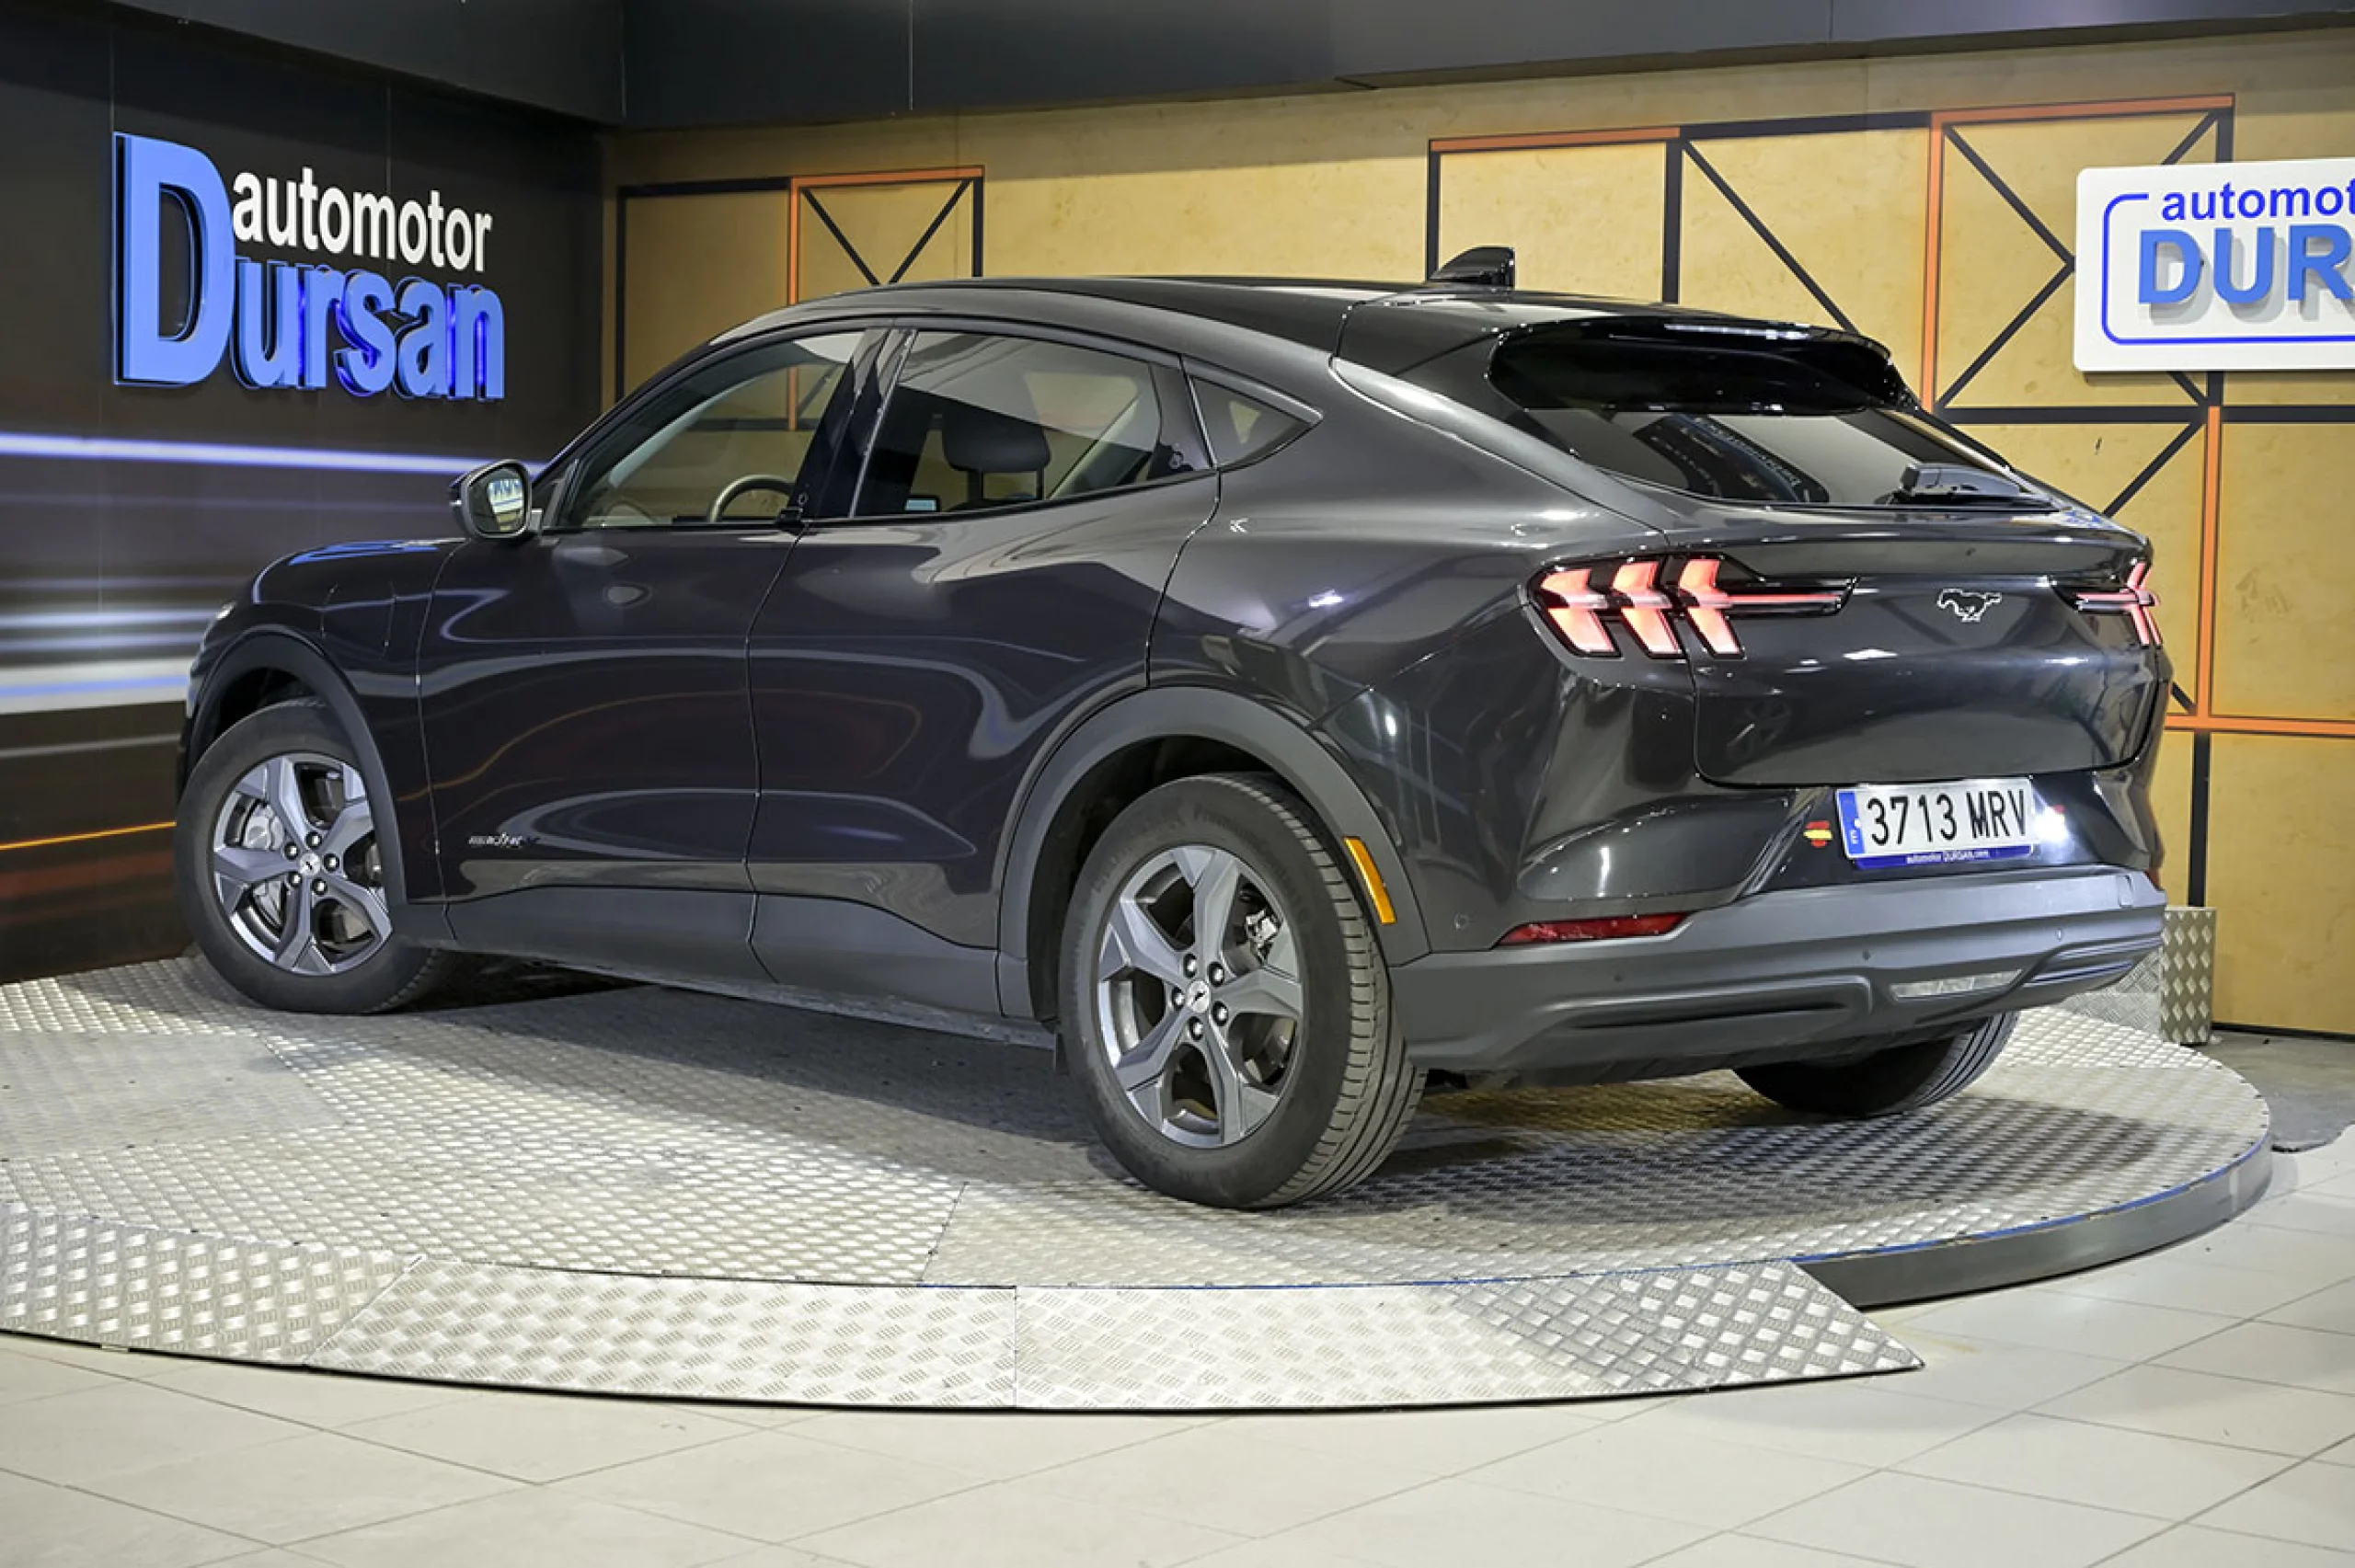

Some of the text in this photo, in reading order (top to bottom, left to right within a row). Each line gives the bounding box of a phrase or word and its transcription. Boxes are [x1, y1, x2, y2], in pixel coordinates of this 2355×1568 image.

[113, 132, 505, 400] Dursan
[233, 166, 493, 271] automotor
[1867, 788, 2027, 846] 3713 MRV
